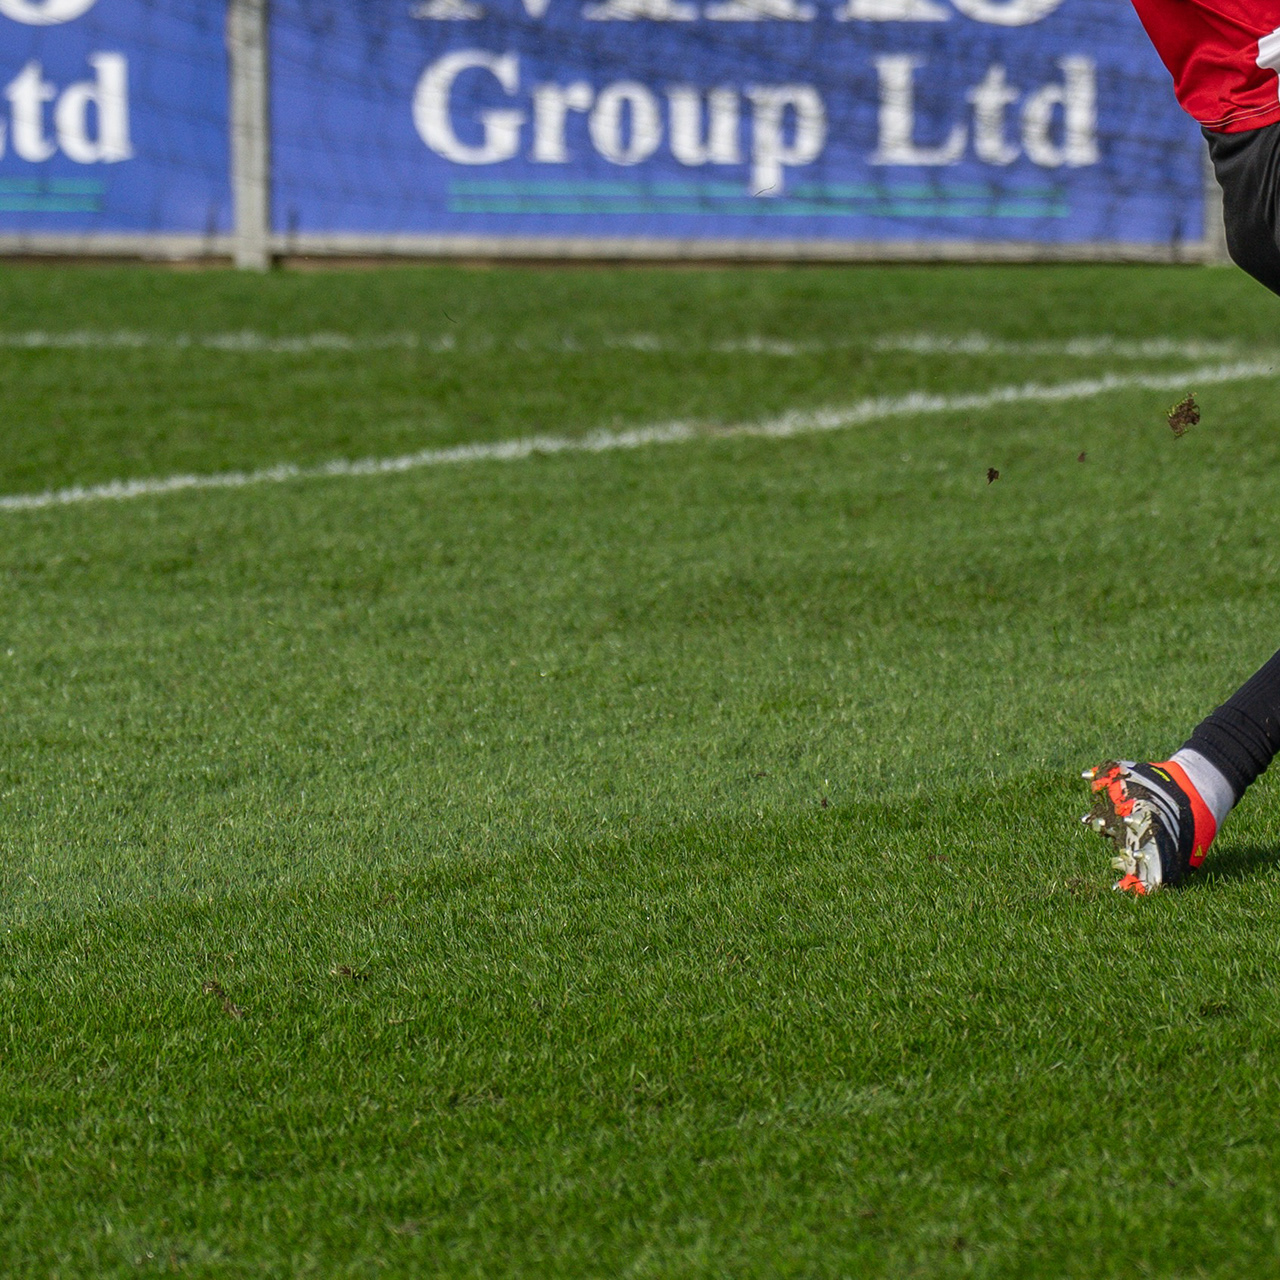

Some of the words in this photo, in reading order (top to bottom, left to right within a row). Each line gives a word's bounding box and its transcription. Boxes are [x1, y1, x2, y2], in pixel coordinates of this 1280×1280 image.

[0, 50, 136, 164] td
[411, 49, 827, 197] Group
[870, 53, 1101, 168] Ltd
